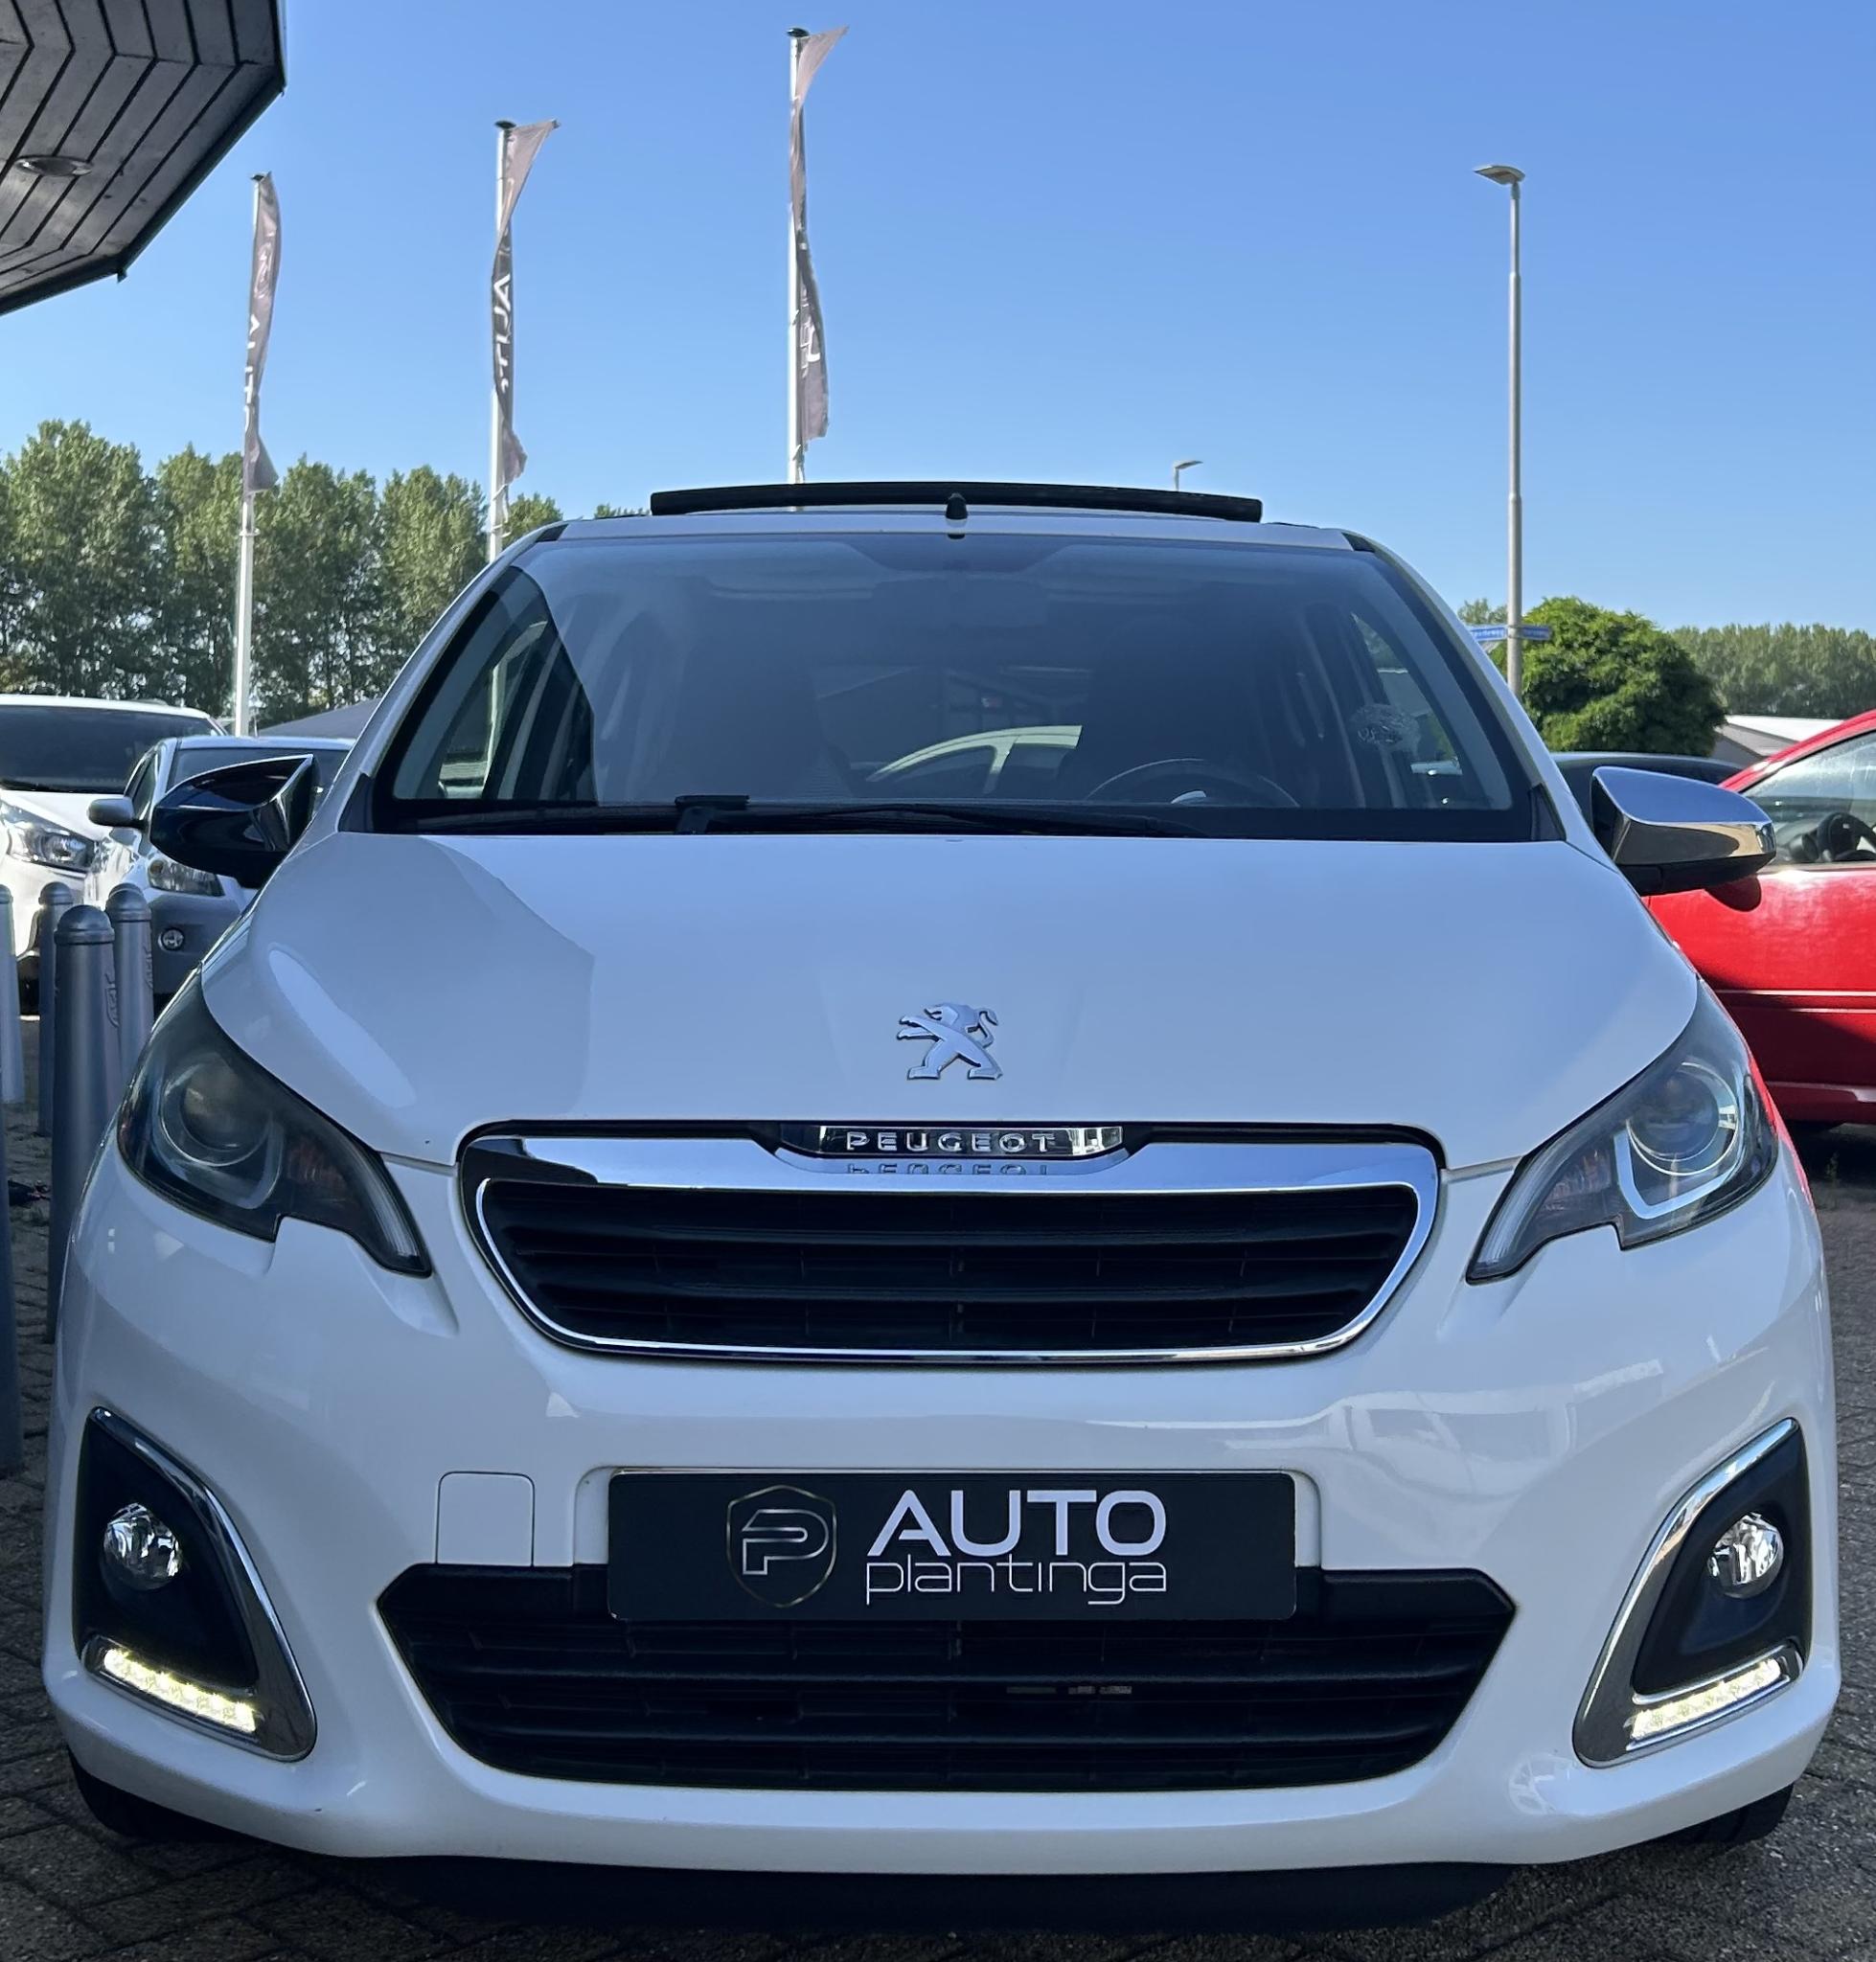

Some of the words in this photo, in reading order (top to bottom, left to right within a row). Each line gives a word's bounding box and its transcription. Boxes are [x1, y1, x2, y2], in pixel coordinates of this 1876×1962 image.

[846, 1131, 1056, 1152] PEUGEOT
[867, 1489, 1167, 1557] AUTO
[867, 1553, 1167, 1606] plantinga
